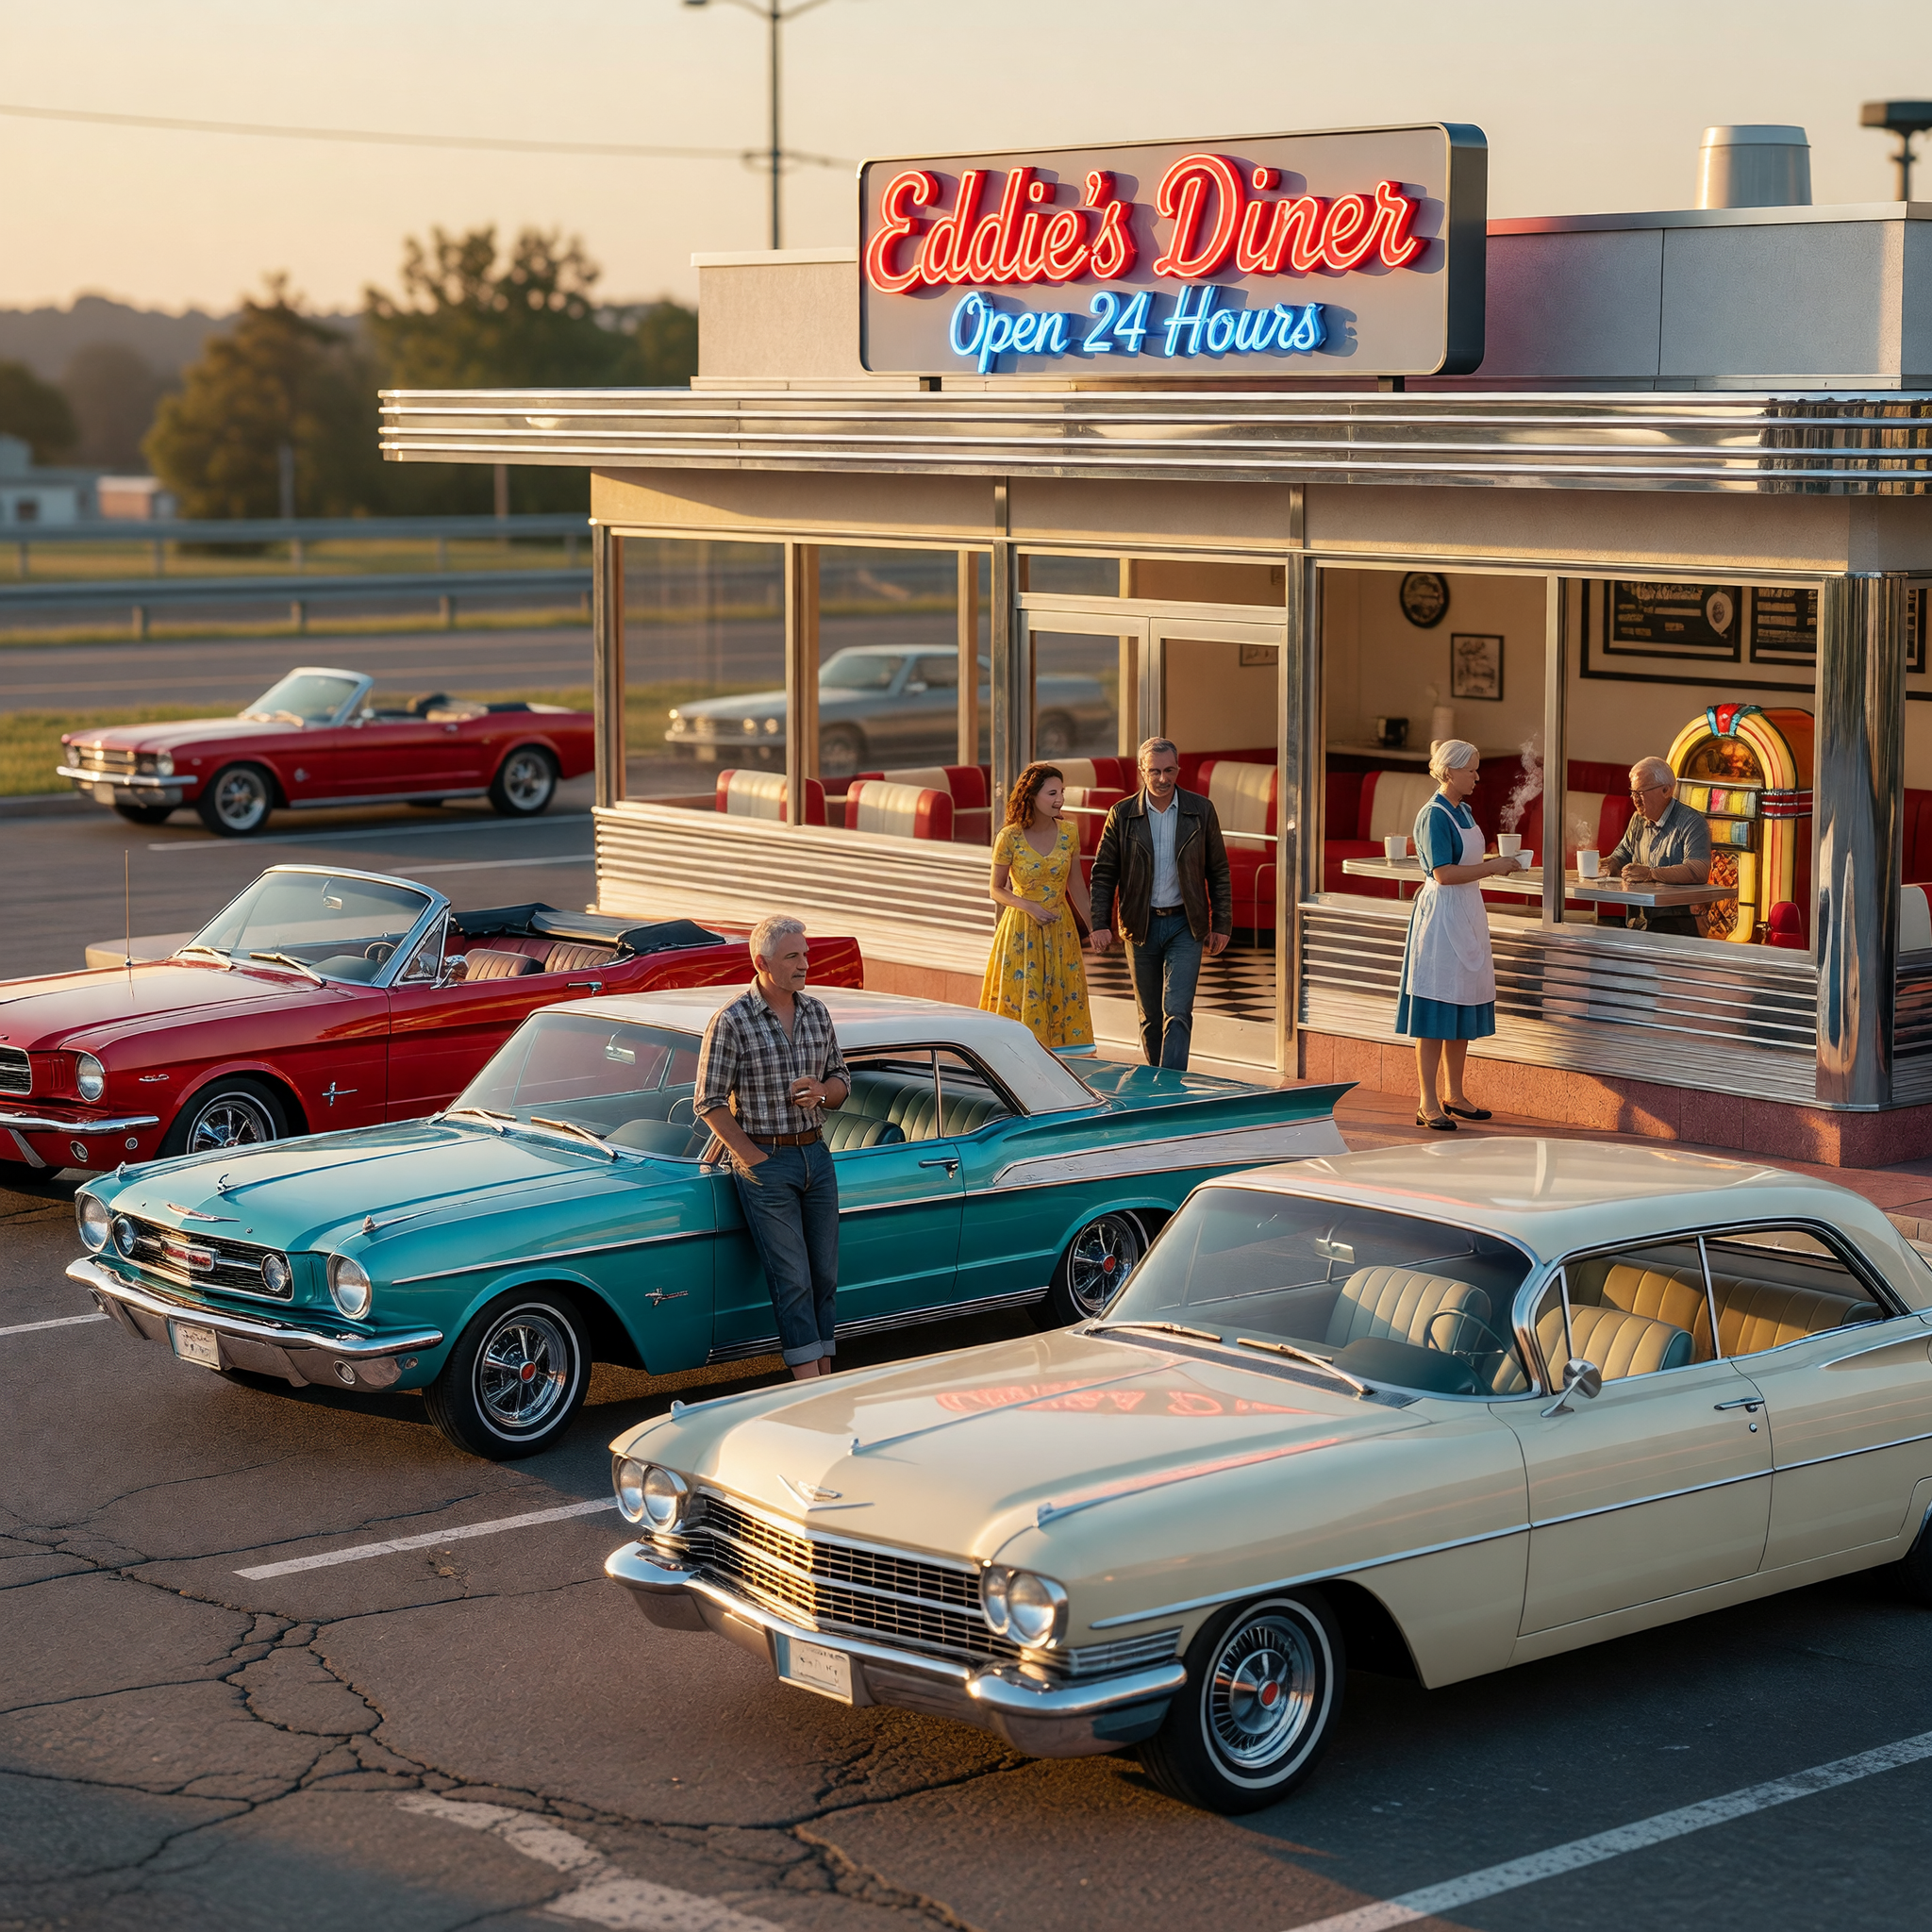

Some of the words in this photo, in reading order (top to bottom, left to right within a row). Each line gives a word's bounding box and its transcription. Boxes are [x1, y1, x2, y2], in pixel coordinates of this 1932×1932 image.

[865, 166, 1138, 294] Eddie's
[1152, 154, 1428, 279] Diner
[949, 291, 1070, 375] Open
[1082, 291, 1155, 354] 24
[1163, 285, 1325, 358] Hours
